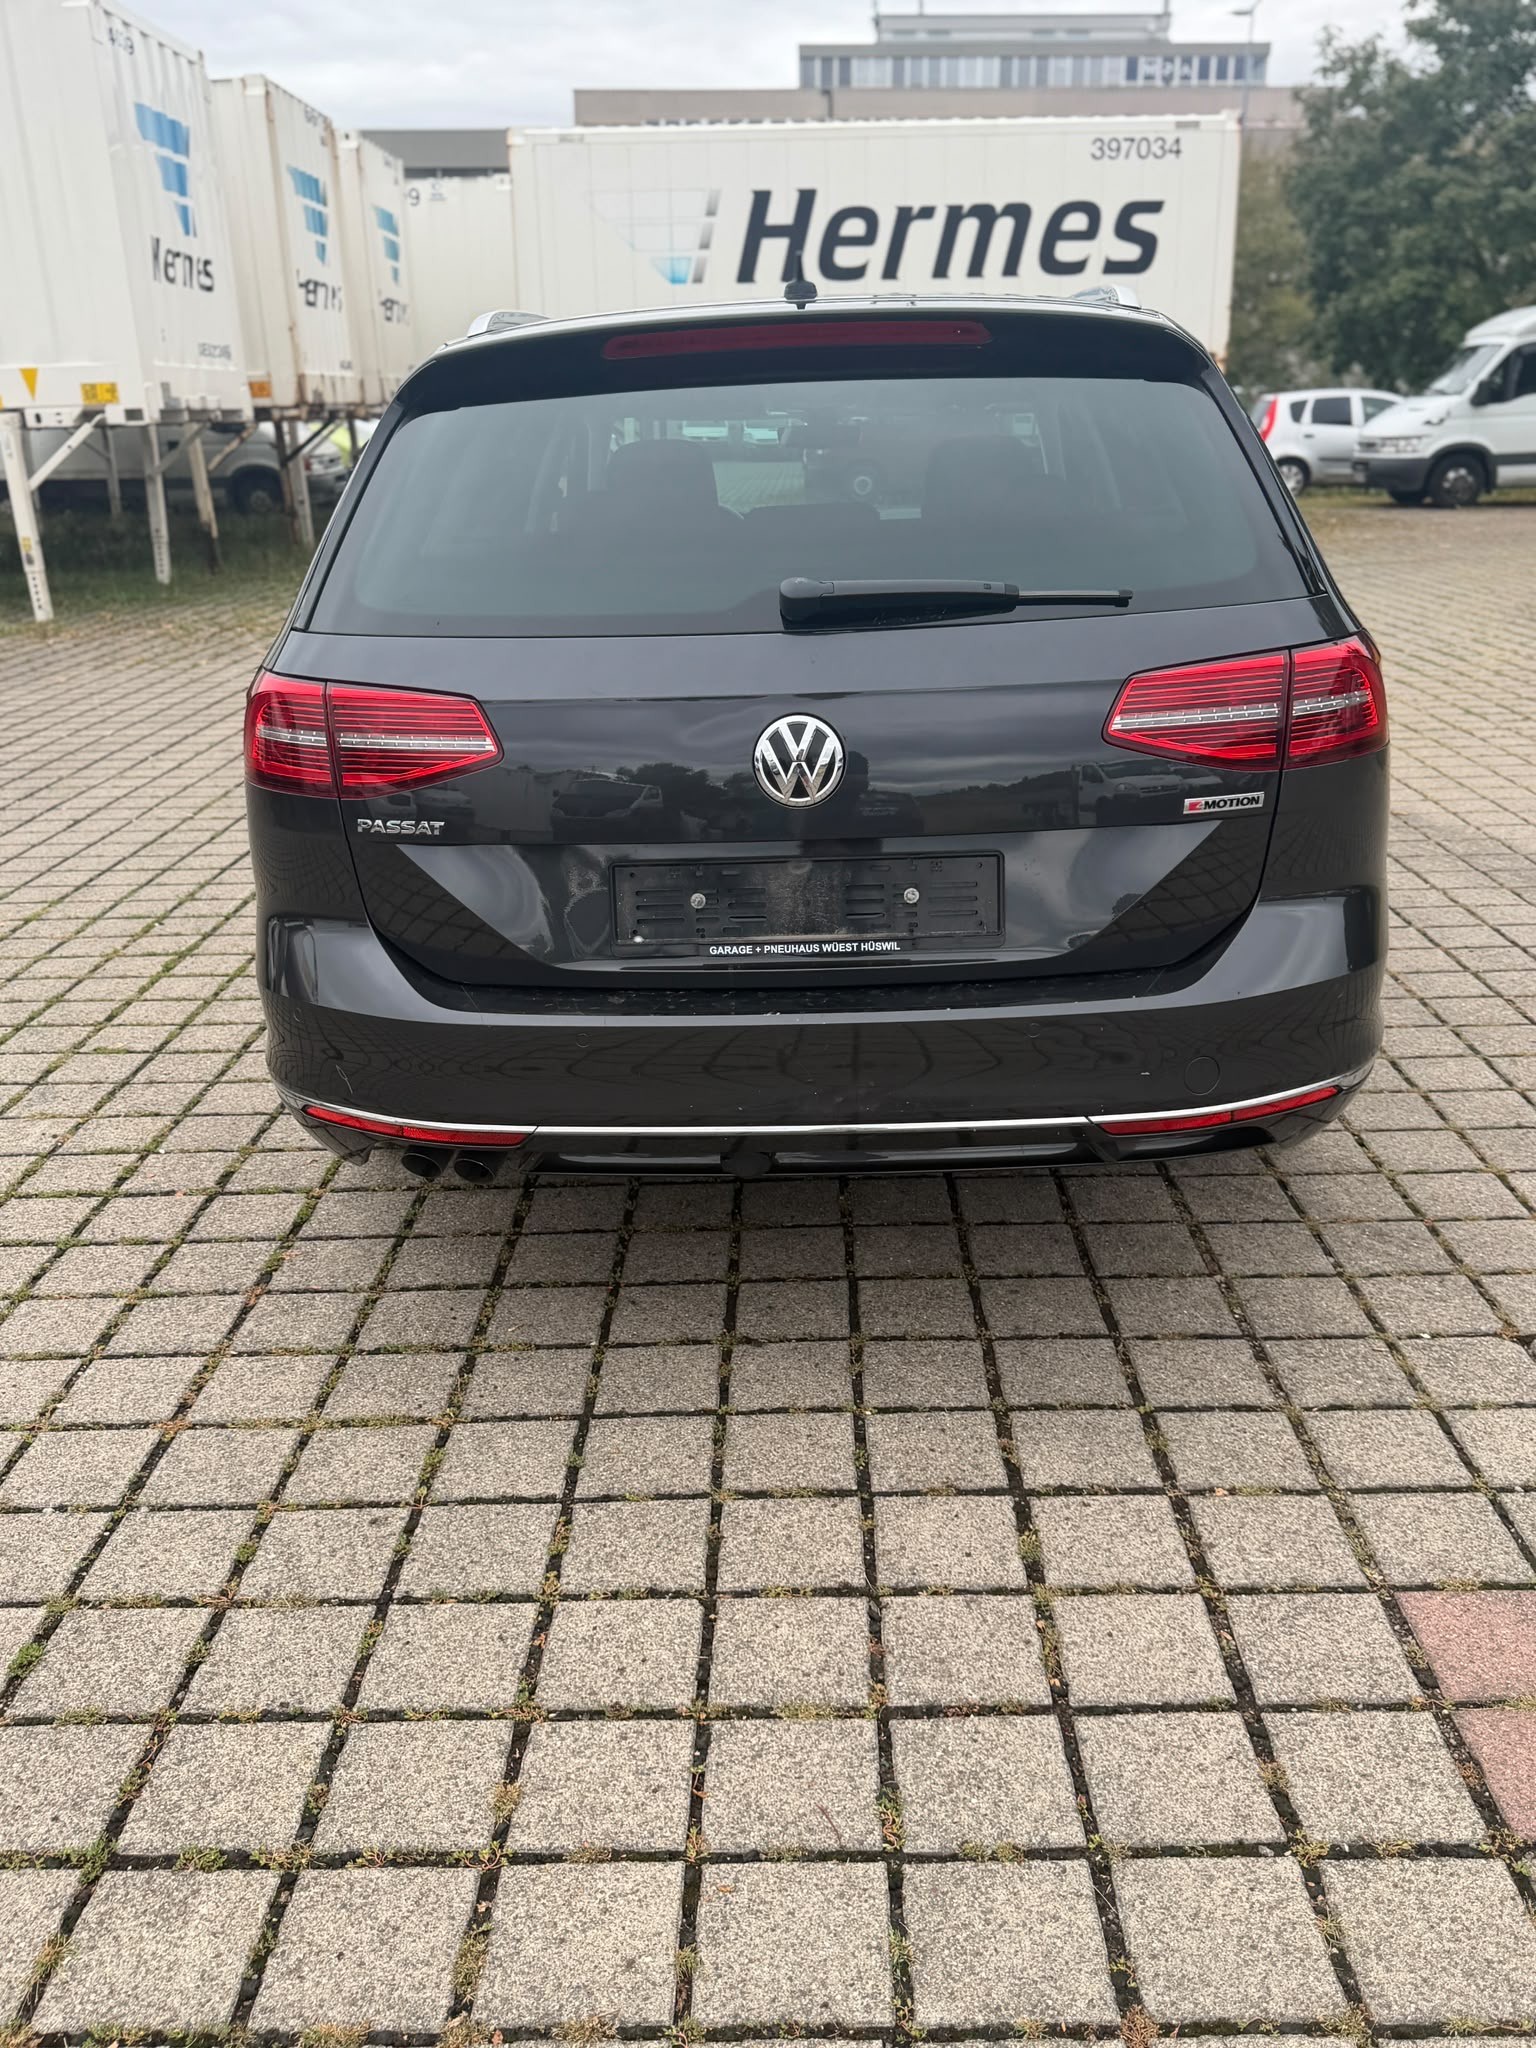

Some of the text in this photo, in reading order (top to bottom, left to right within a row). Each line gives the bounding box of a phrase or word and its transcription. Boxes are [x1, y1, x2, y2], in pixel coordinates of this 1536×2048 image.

[1091, 136, 1182, 160] 397034
[736, 188, 1165, 284] Hermes
[357, 818, 445, 835] PASSAT
[709, 945, 753, 955] GARAGE
[764, 944, 820, 954] PNEUHAUS
[822, 942, 859, 952] WÜEST
[860, 941, 901, 951] HÜSWIL
